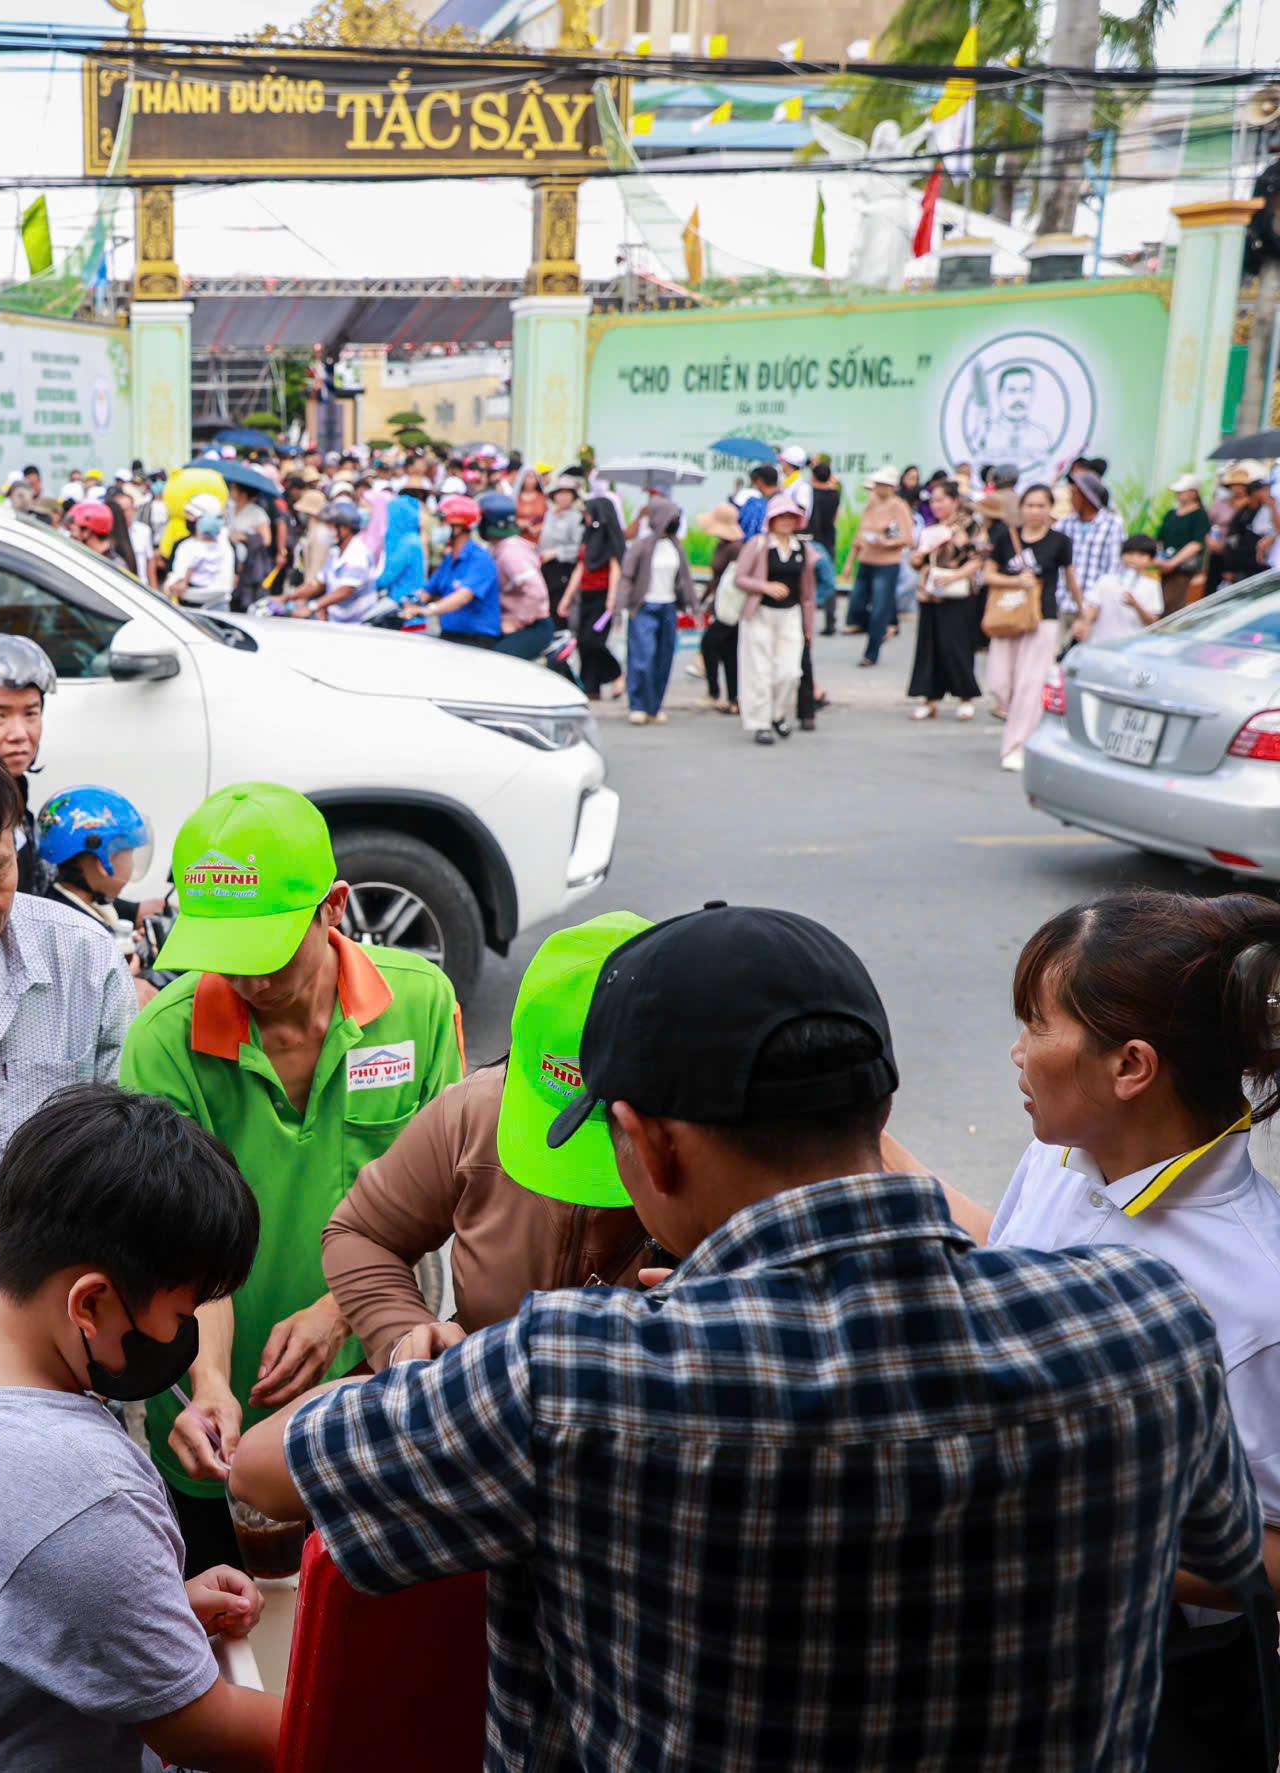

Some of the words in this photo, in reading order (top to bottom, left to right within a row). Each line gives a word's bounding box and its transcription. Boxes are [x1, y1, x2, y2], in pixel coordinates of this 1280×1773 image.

[336, 67, 461, 150] TẮC
[469, 79, 593, 160] SẬY
[757, 355, 819, 398] ĐƯỢC
[212, 873, 258, 885] VINH
[384, 1061, 411, 1075] VINH
